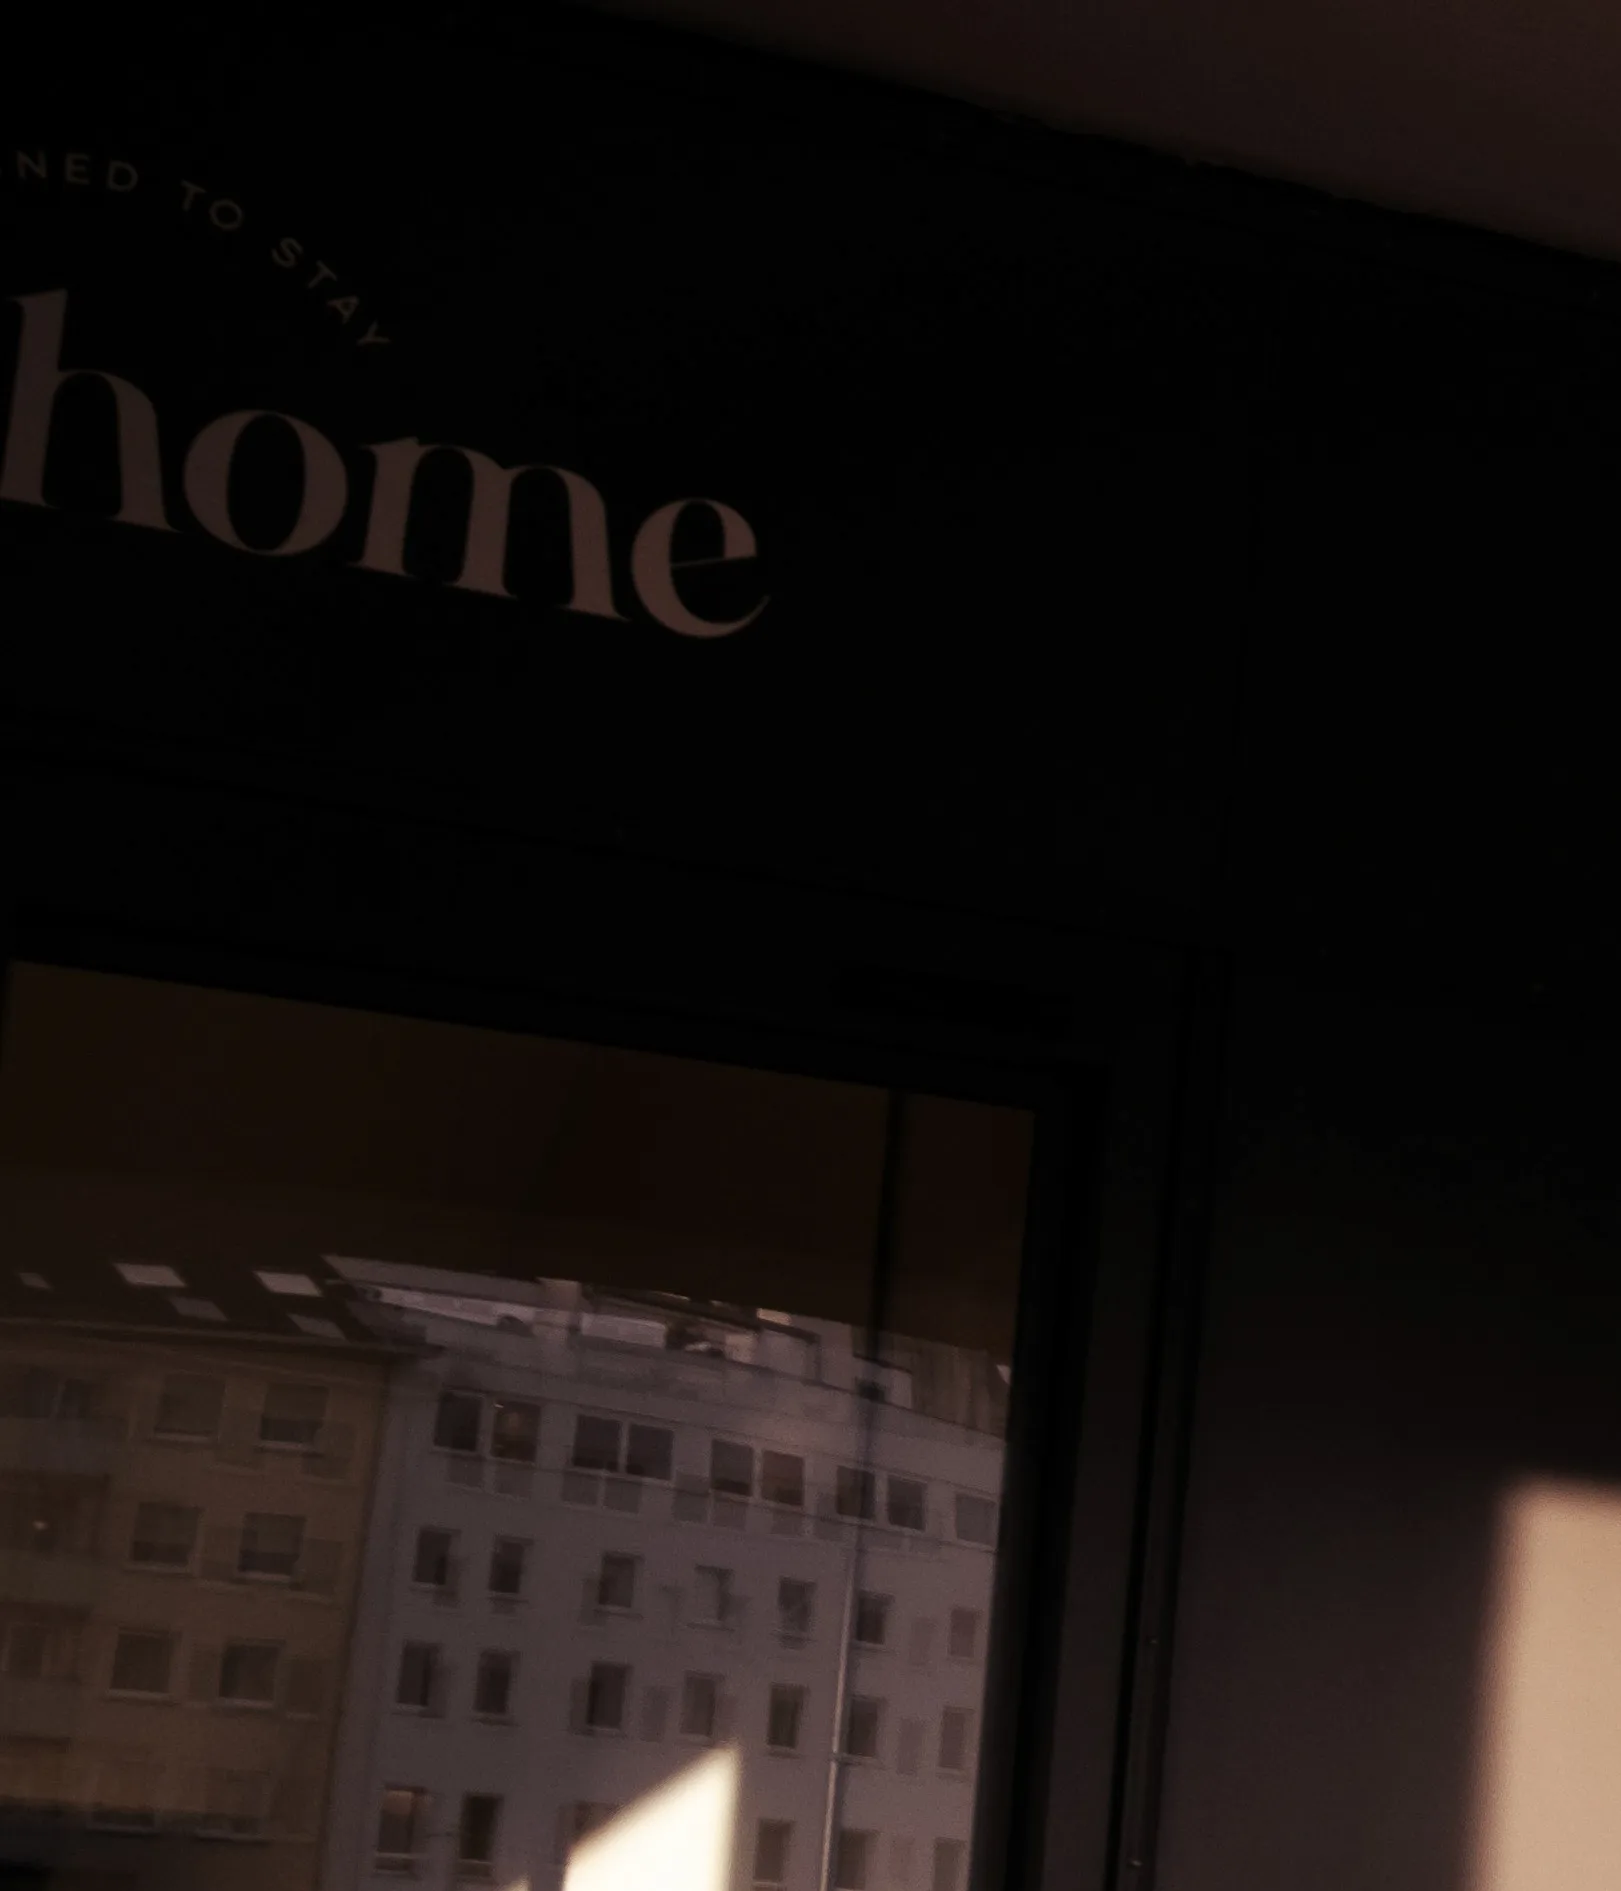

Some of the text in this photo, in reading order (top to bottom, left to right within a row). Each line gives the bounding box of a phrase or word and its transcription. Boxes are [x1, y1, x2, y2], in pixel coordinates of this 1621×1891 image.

[0, 150, 392, 349] NED TO STAY
[0, 287, 771, 640] home
